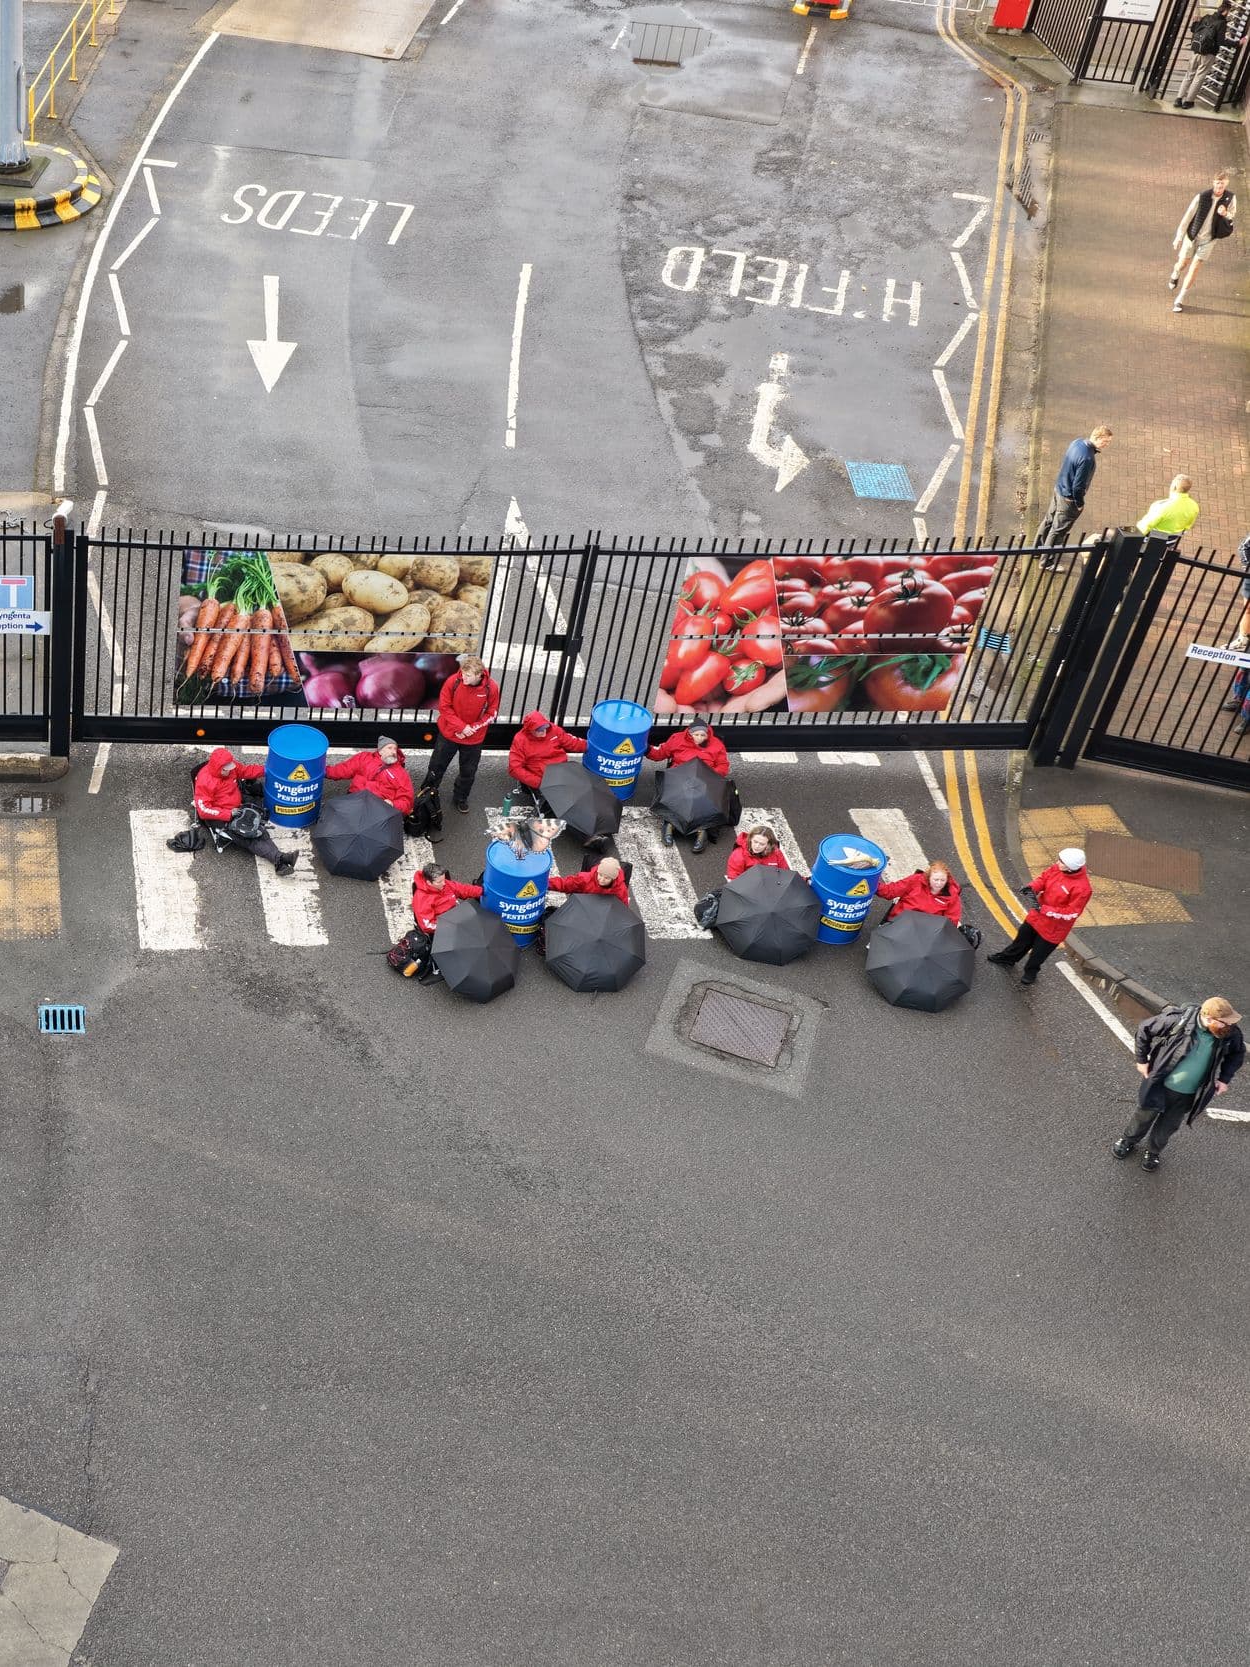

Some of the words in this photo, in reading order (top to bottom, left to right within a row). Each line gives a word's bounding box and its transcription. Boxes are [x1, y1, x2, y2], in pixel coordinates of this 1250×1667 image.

[220, 184, 415, 245] LEEDS
[1190, 647, 1236, 662] Reception
[596, 755, 641, 769] syngenta
[599, 766, 636, 775] PESTICIDE
[273, 781, 319, 795] syngenta
[277, 793, 314, 802] PESTICIDE
